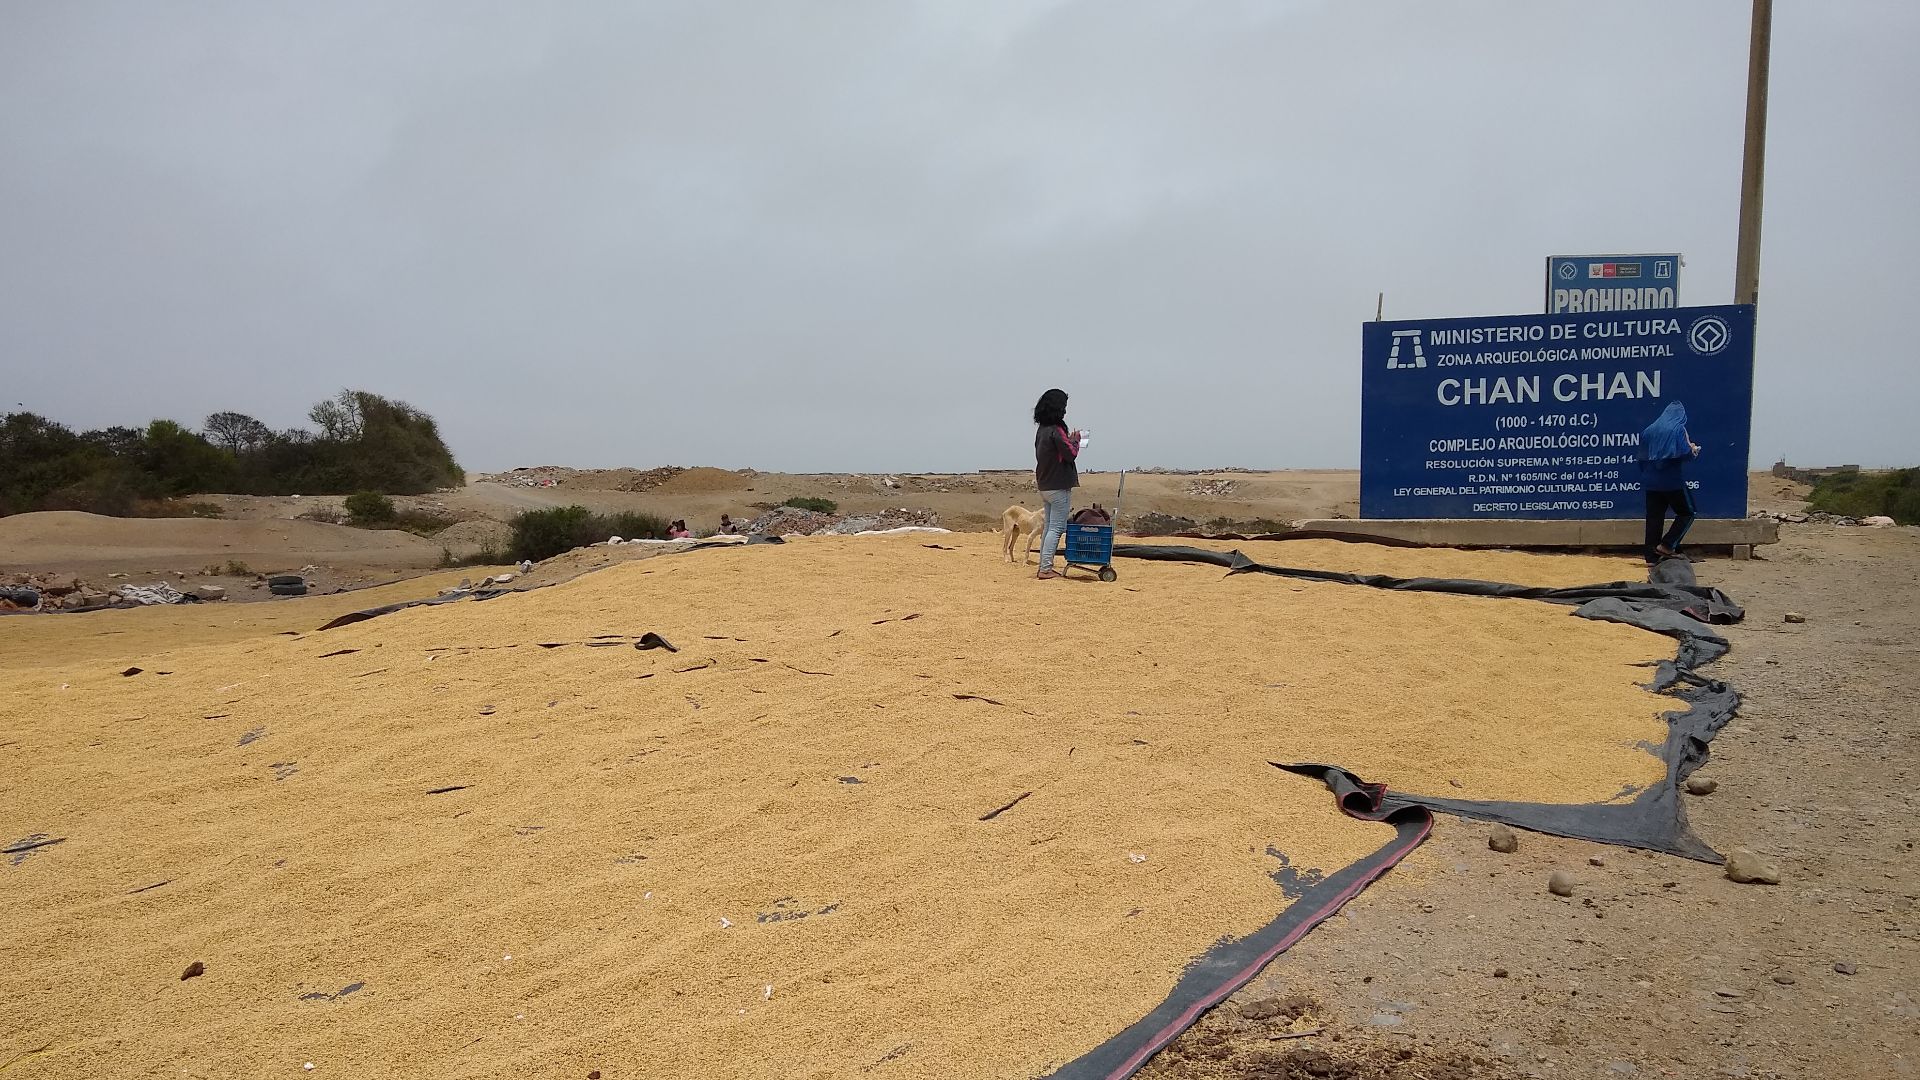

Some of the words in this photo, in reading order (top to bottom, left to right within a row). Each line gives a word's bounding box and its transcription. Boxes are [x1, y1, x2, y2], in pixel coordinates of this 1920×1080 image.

[1431, 326, 1544, 345] MINISTERIO
[1551, 324, 1577, 340] DE
[1584, 319, 1682, 338] CULTURA
[1438, 354, 1472, 366] ZONA
[1475, 348, 1578, 364] ARQUEOLÓGICA
[1582, 345, 1674, 360] MONUMENTAL
[1437, 376, 1540, 406] CHAN
[1554, 370, 1661, 402] CHAN
[1496, 416, 1528, 431] (1000
[1539, 415, 1566, 427] 1470
[1570, 413, 1598, 428] d.C.)
[1430, 439, 1496, 452] COMPLEJO
[1498, 433, 1599, 449] ARQUEOLÓGICO
[1603, 433, 1640, 446] INTAN
[1426, 457, 1494, 469] RESOLUCIÓN
[1497, 458, 1549, 468] SUPREMA
[1565, 456, 1602, 465] 518-ED
[1604, 456, 1619, 464] del
[1622, 455, 1637, 464] 14-
[1469, 474, 1498, 482] R.D.N.
[1515, 473, 1557, 482] 1605/INC
[1561, 472, 1575, 480] del
[1578, 471, 1619, 479] 04-11-08
[1394, 488, 1411, 496] LEY
[1414, 487, 1457, 496] GENERAL
[1459, 487, 1477, 495] DEL
[1480, 485, 1536, 494] PATRIMONIO
[1538, 484, 1587, 493] CULTURAL
[1589, 483, 1602, 492] DE
[1605, 483, 1618, 491] LA
[1620, 482, 1640, 491] NAC
[1685, 481, 1700, 489] 96
[1474, 503, 1518, 512] DECRETO
[1520, 501, 1580, 511] LEGISLATIVO
[1582, 501, 1614, 509] 635-ED
